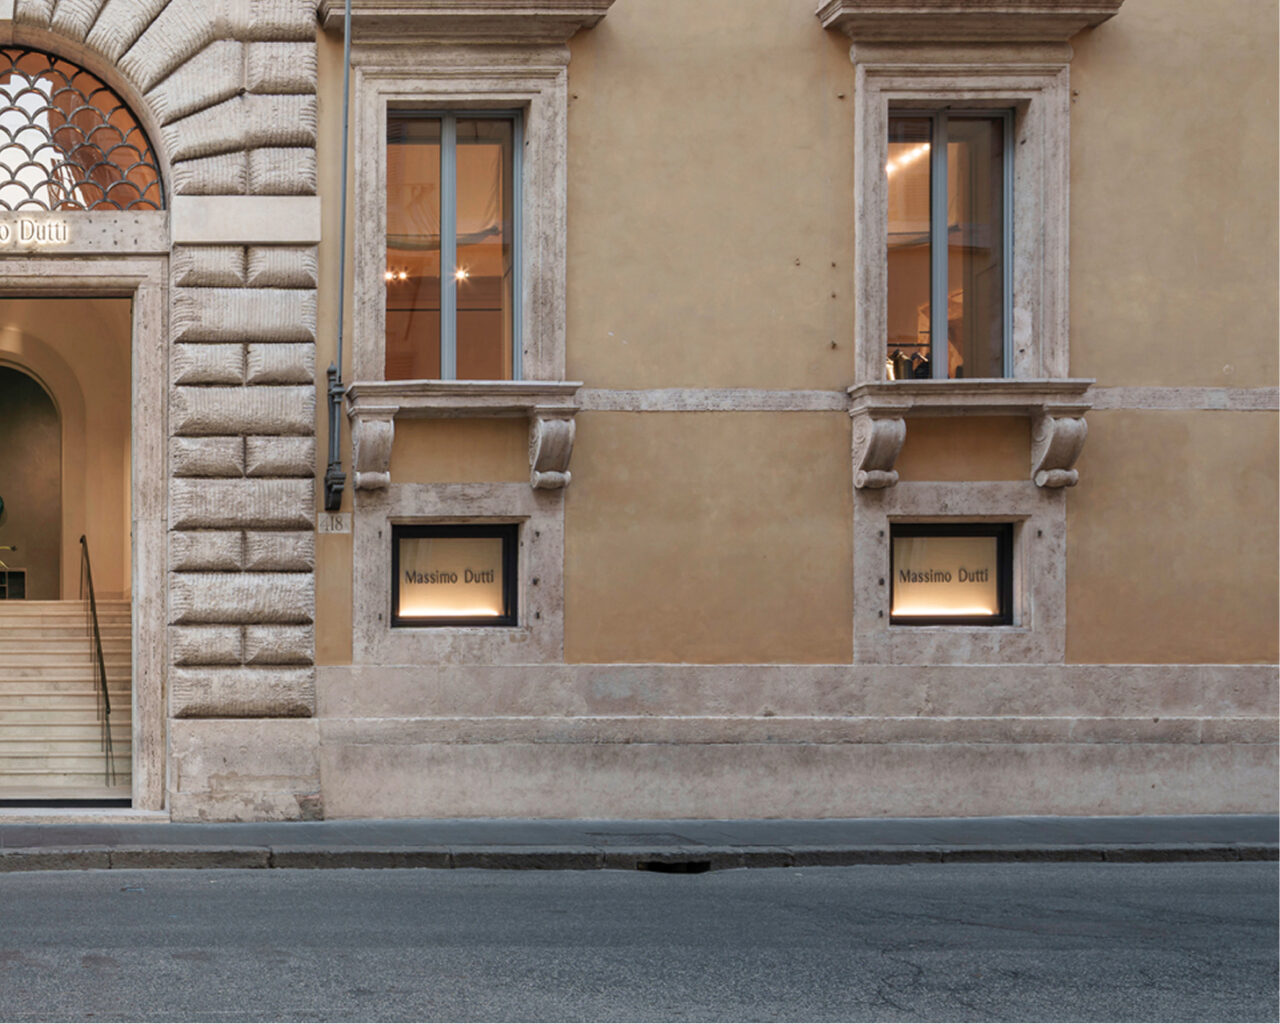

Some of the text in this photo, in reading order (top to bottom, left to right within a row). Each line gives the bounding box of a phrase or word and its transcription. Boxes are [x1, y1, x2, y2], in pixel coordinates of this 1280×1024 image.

[20, 220, 67, 241] Dutti
[405, 569, 494, 584] Massimo Dutti
[900, 568, 988, 583] Massimo Dutti
